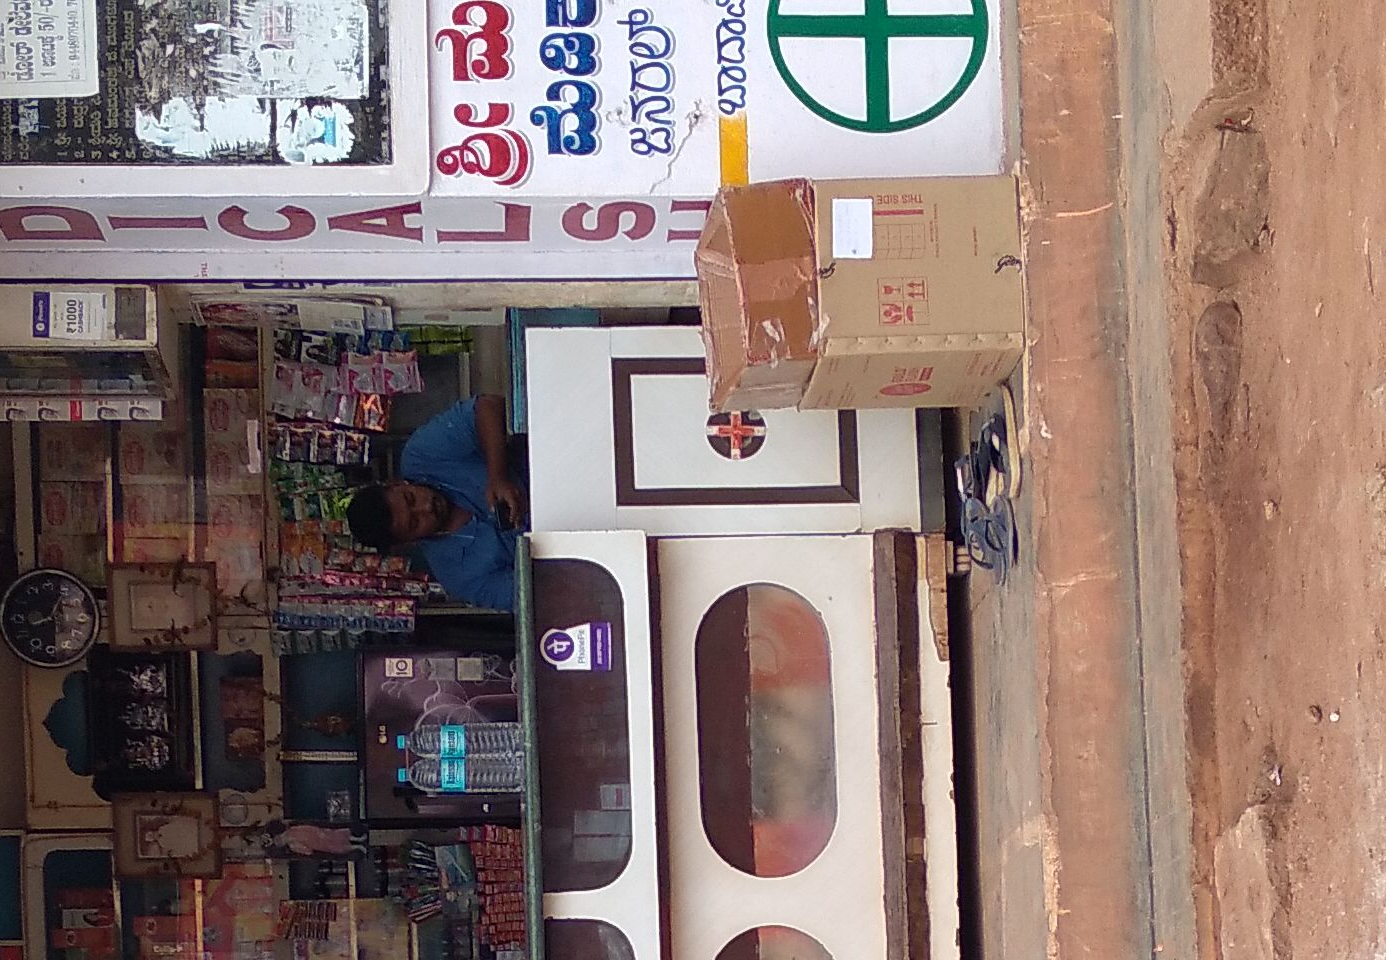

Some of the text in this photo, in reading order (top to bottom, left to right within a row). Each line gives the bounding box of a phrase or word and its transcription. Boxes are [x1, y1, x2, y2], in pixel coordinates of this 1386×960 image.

[616, 8, 673, 156] ಜನರಲ್
[436, 101, 529, 187] ಶ್ರೀ
[875, 193, 924, 205] THIS SIDE
[66, 299, 77, 334] ₹1000
[577, 629, 586, 664] PhonePe
